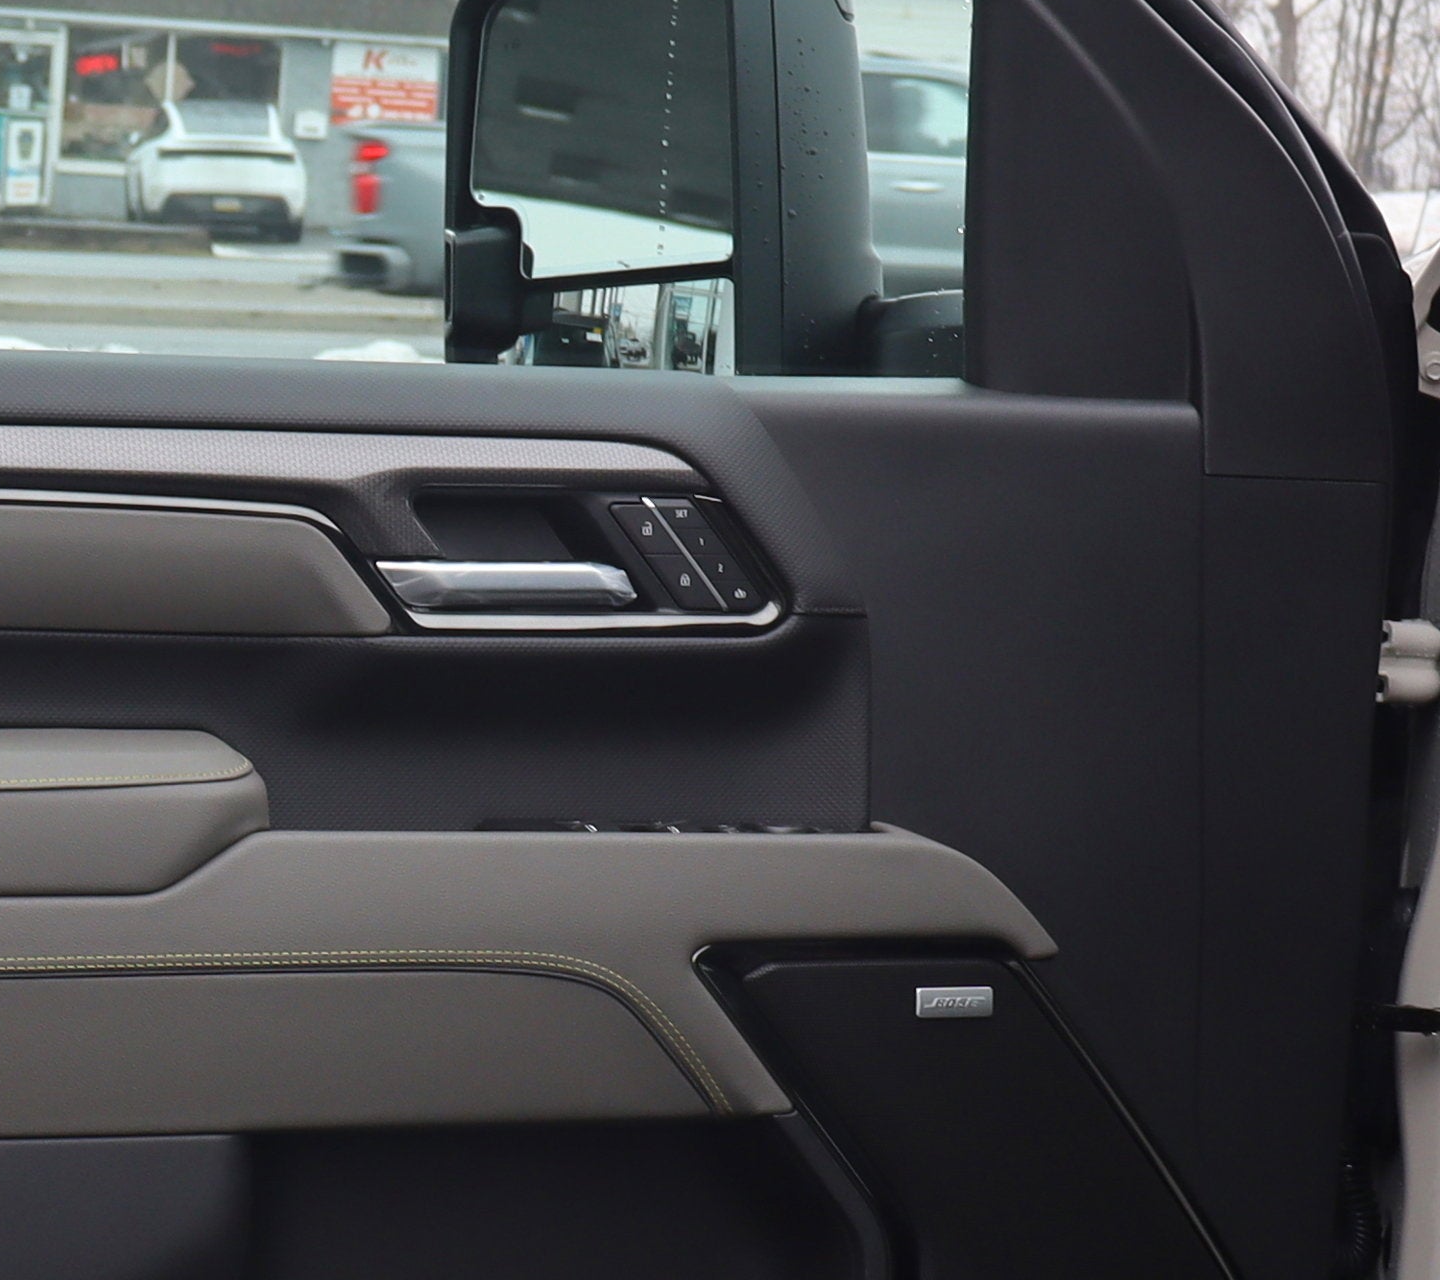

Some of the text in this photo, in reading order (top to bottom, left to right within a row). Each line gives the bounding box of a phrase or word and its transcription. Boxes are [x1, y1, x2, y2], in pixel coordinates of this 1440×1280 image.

[675, 509, 688, 518] SET
[698, 537, 705, 546] 1
[718, 563, 724, 573] 2
[924, 996, 985, 1009] BOSE
